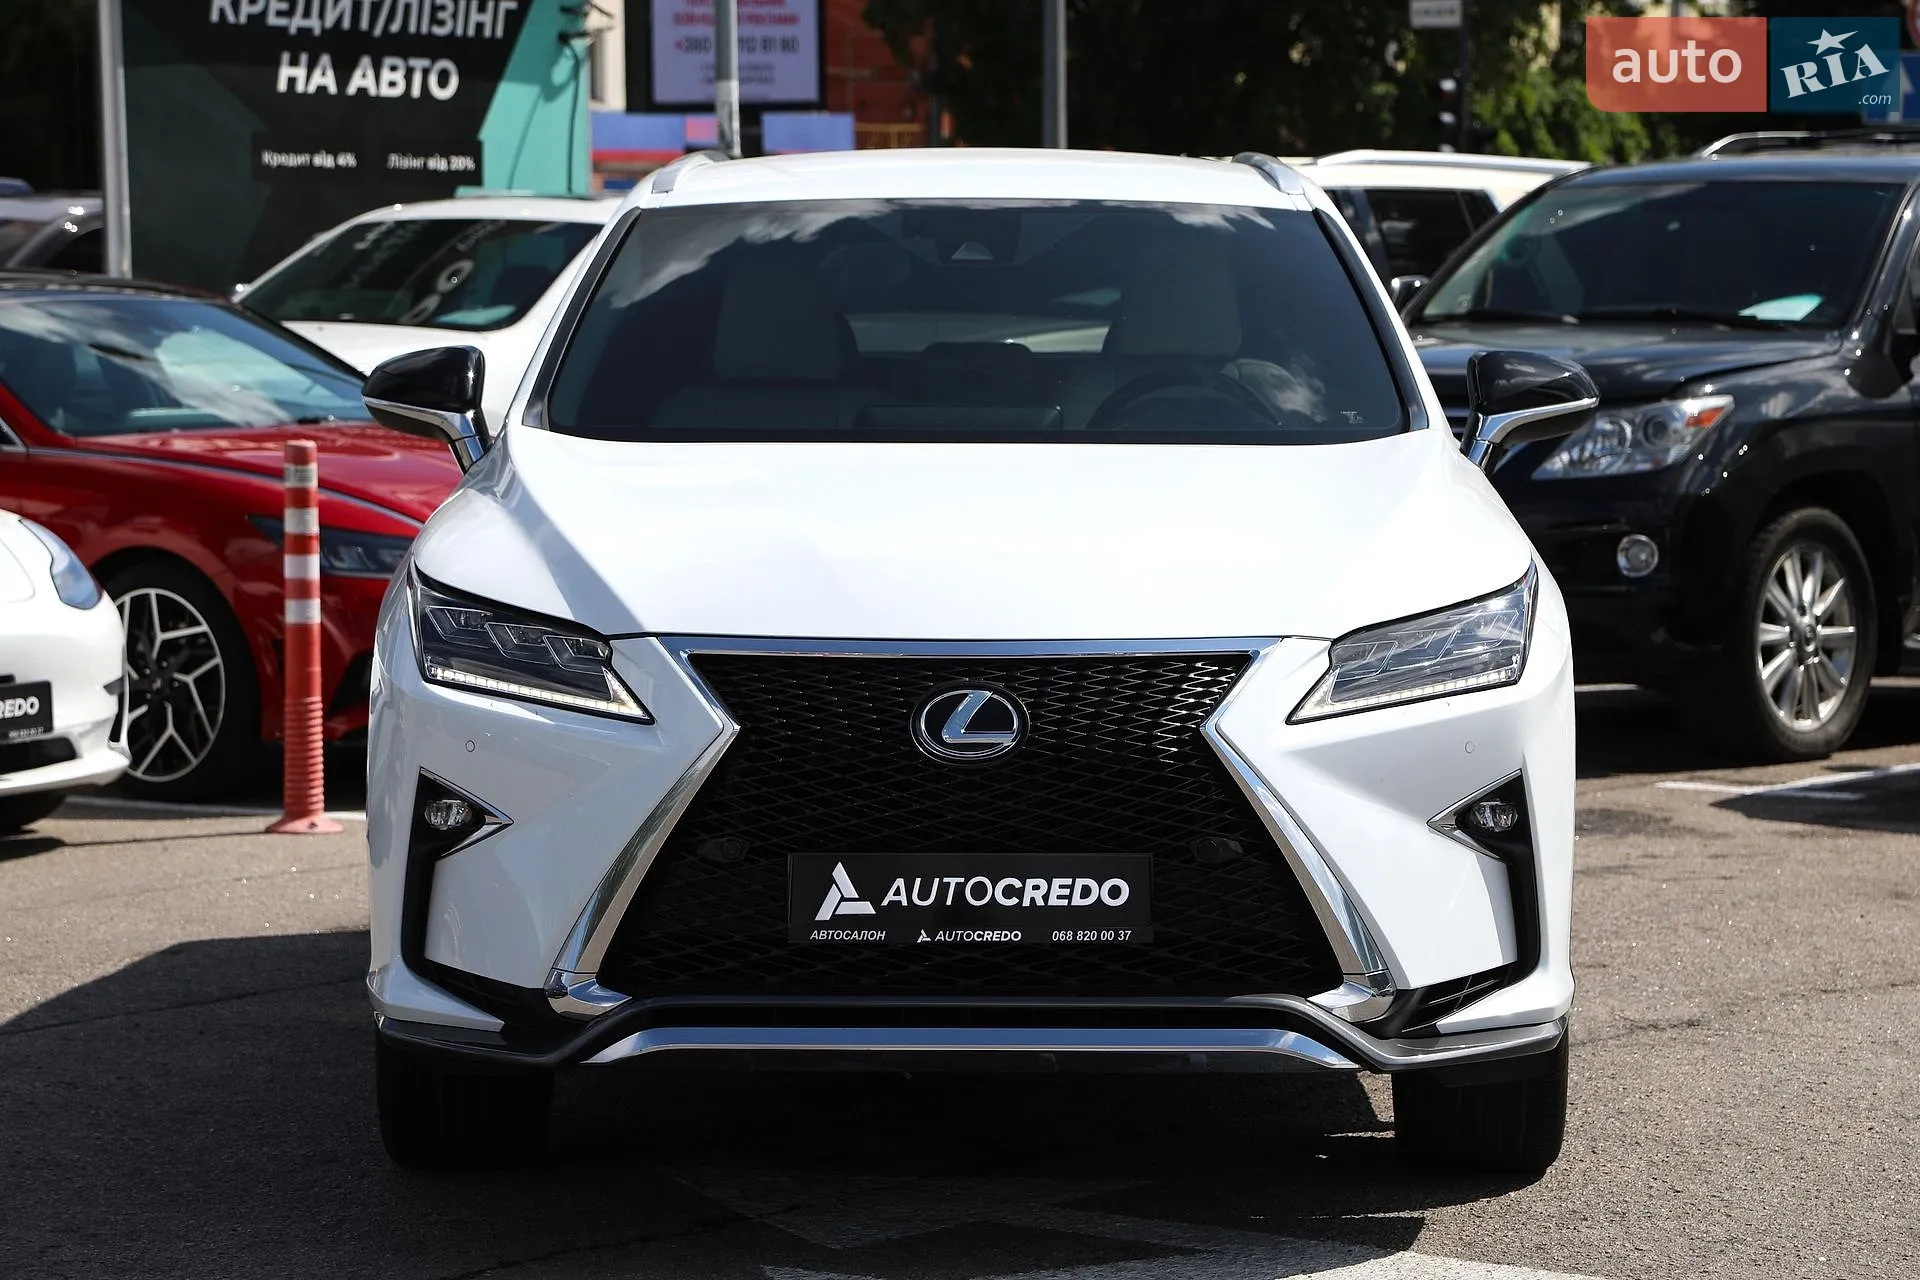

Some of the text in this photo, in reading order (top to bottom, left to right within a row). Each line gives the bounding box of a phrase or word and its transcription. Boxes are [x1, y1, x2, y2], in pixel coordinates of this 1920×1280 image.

[209, 0, 518, 39] КРЕДИТ/ЛІЗІНГ
[276, 51, 460, 101] НА АВТО
[880, 875, 1130, 907] AUTOCREDO
[809, 929, 887, 942] АВТОСАЛОН
[934, 930, 1022, 942] AUTOCREDO
[1051, 930, 1132, 942] 068 820 00 37
